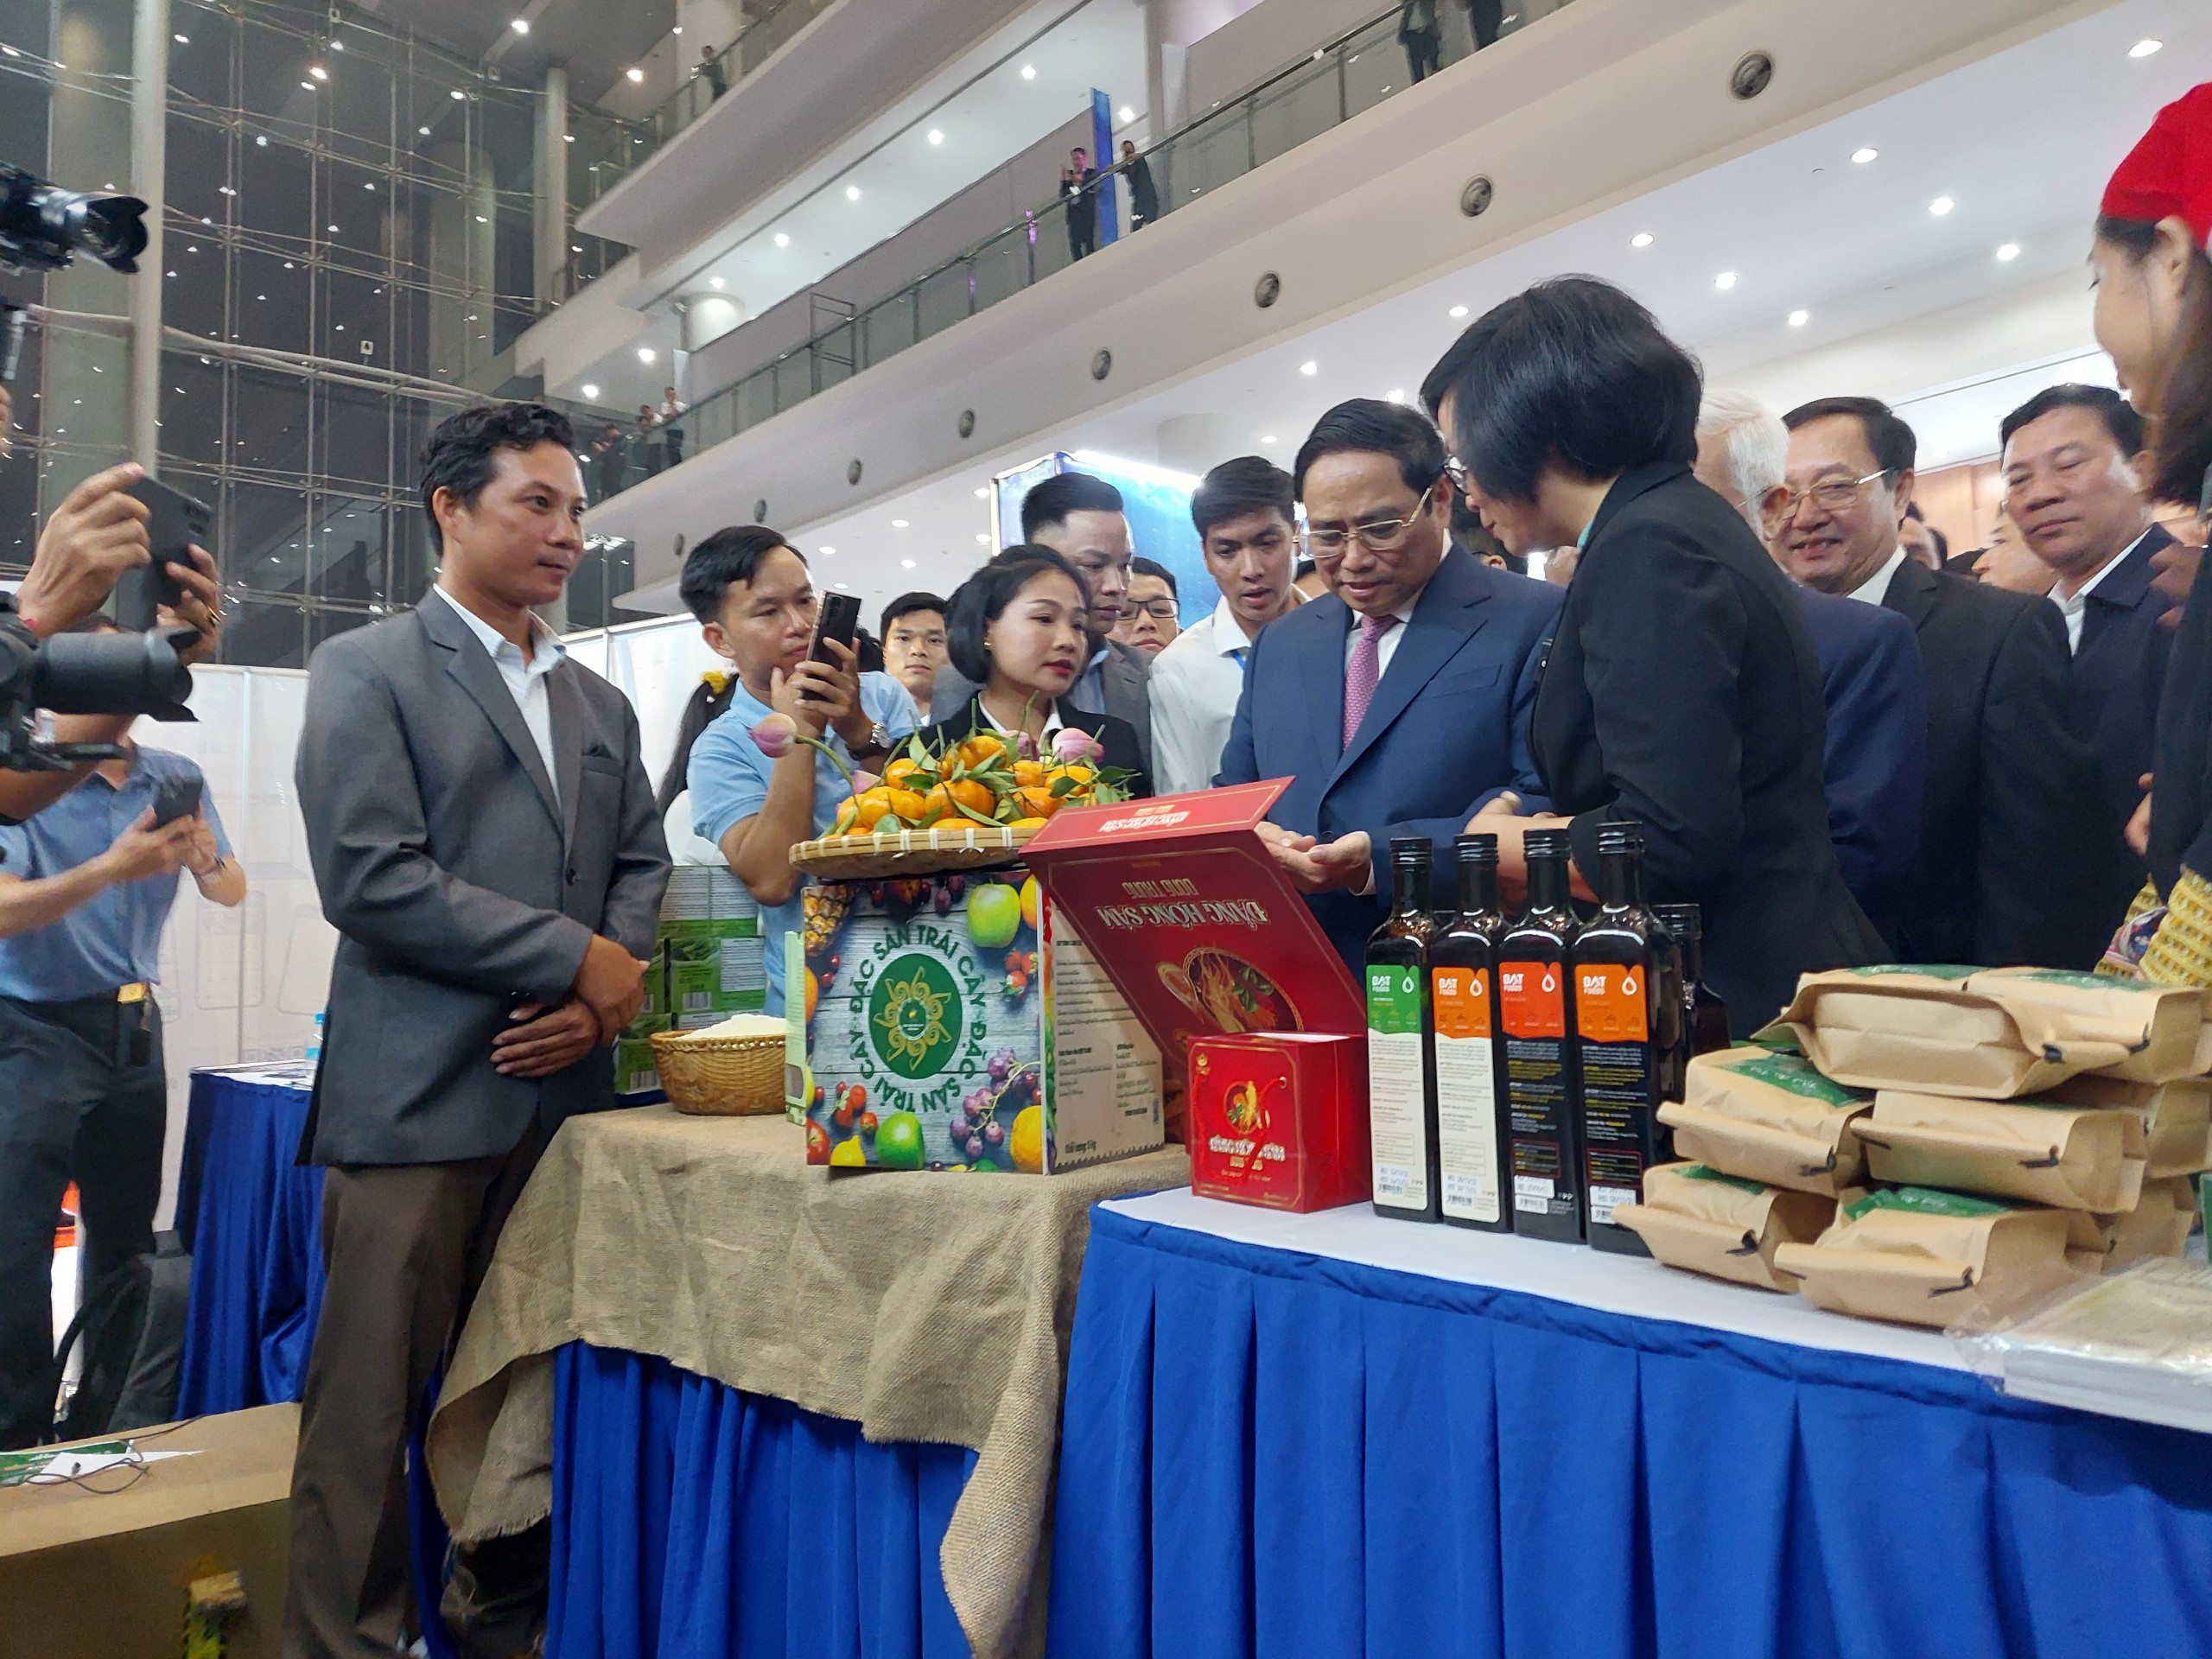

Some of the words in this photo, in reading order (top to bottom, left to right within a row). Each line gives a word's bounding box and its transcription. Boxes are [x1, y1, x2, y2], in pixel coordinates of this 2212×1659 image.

[1144, 901, 1206, 929] HỒNG
[849, 959, 874, 1013] ĐẶC
[873, 926, 911, 961] SẢN
[917, 925, 959, 960] TRÁI
[957, 956, 986, 1007] CÂY
[849, 1030, 874, 1079] CÂY
[959, 1021, 988, 1079] ĐẶC
[874, 1077, 916, 1113] TRÁI
[922, 1077, 961, 1113] SẢN
